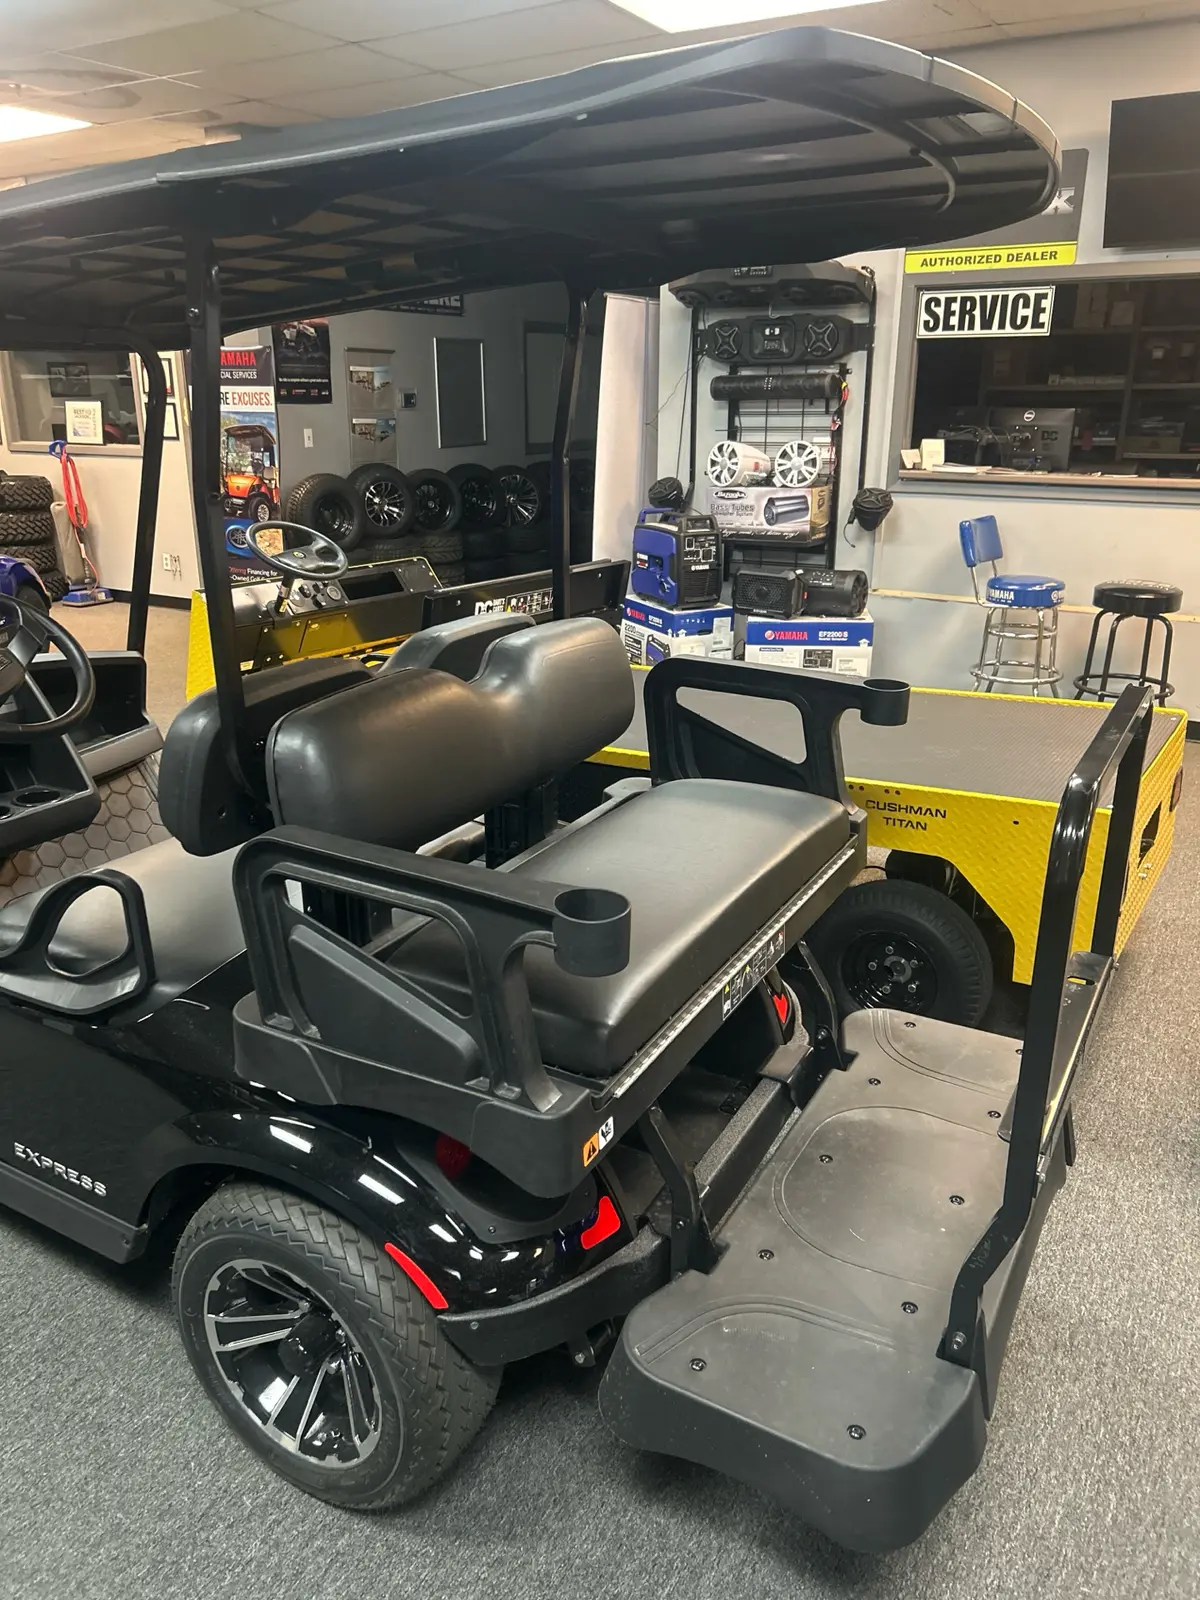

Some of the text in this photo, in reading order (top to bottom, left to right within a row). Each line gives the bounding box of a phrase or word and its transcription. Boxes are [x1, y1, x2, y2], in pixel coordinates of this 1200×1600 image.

[920, 250, 1058, 267] AUTHORIZED DEALER
[923, 292, 1049, 333] SERVICE
[220, 351, 256, 366] AMAHA
[220, 371, 257, 379] CIAL SERVICES
[220, 392, 230, 406] RE
[232, 391, 273, 406] EXCUSES.
[247, 568, 270, 577] Financing
[775, 631, 808, 641] YAMAHA
[865, 800, 947, 819] CUSHMAN
[883, 816, 927, 831] TITAN
[14, 1141, 107, 1197] EXPRESS
